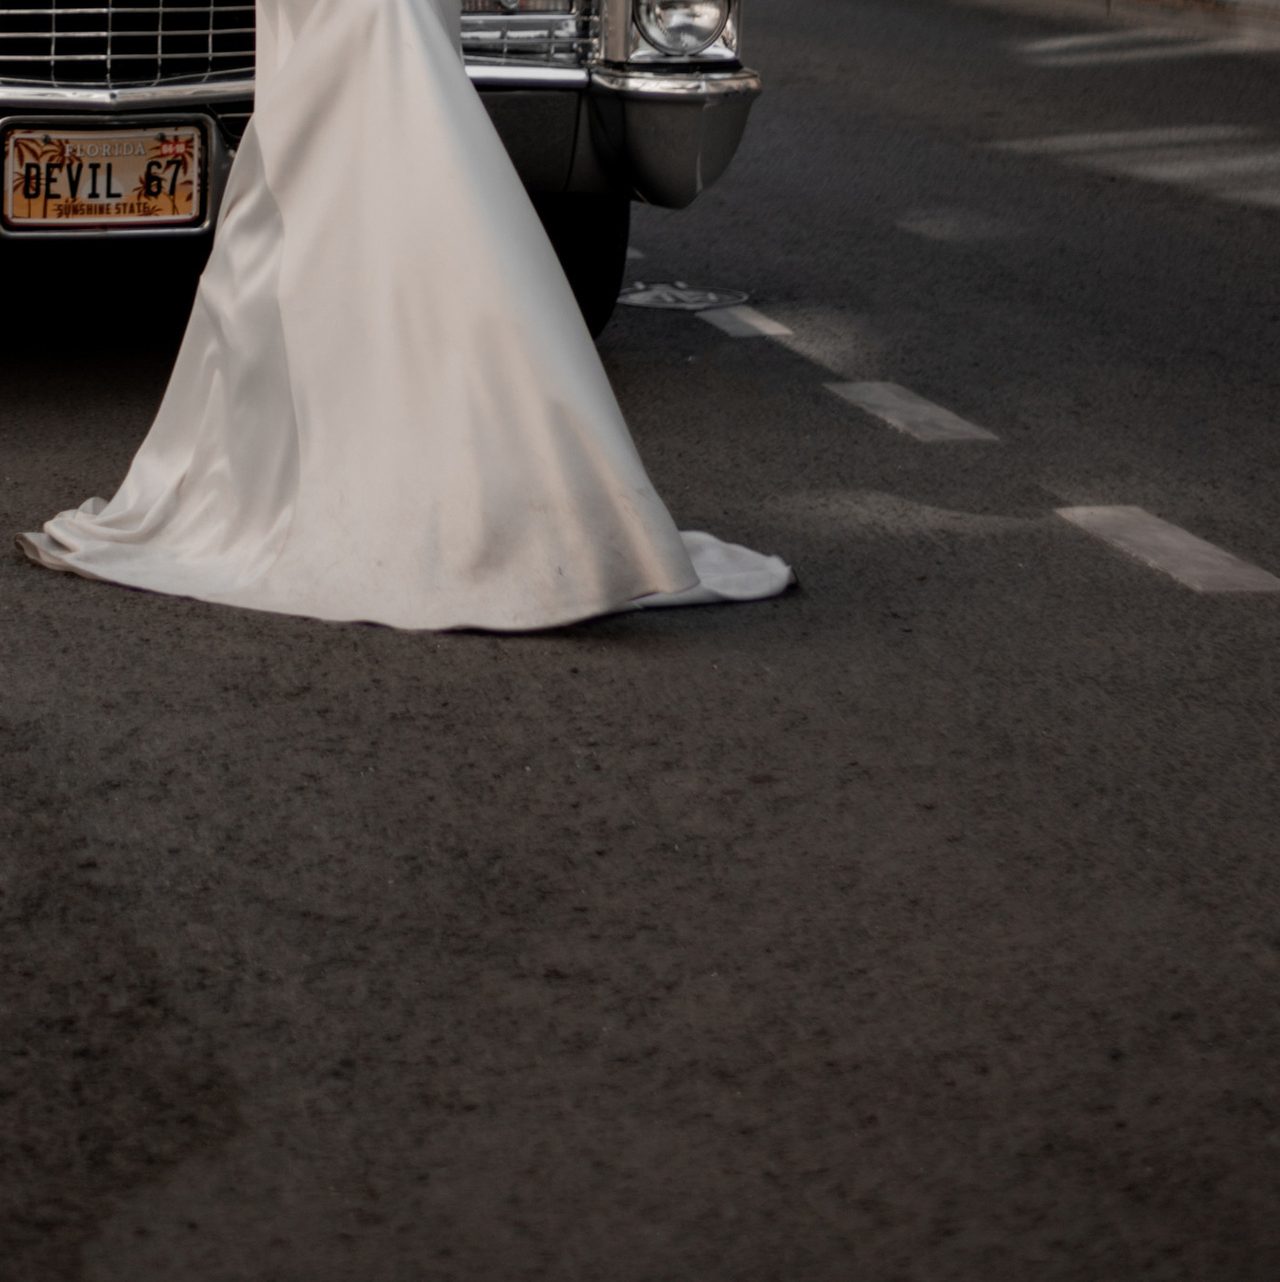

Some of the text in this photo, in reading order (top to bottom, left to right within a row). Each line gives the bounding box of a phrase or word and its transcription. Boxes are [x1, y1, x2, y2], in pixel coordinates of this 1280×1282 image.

[64, 142, 146, 157] FLORIDA
[24, 160, 182, 199] DEVIL 67
[57, 201, 148, 216] SUNSHINE STATE
